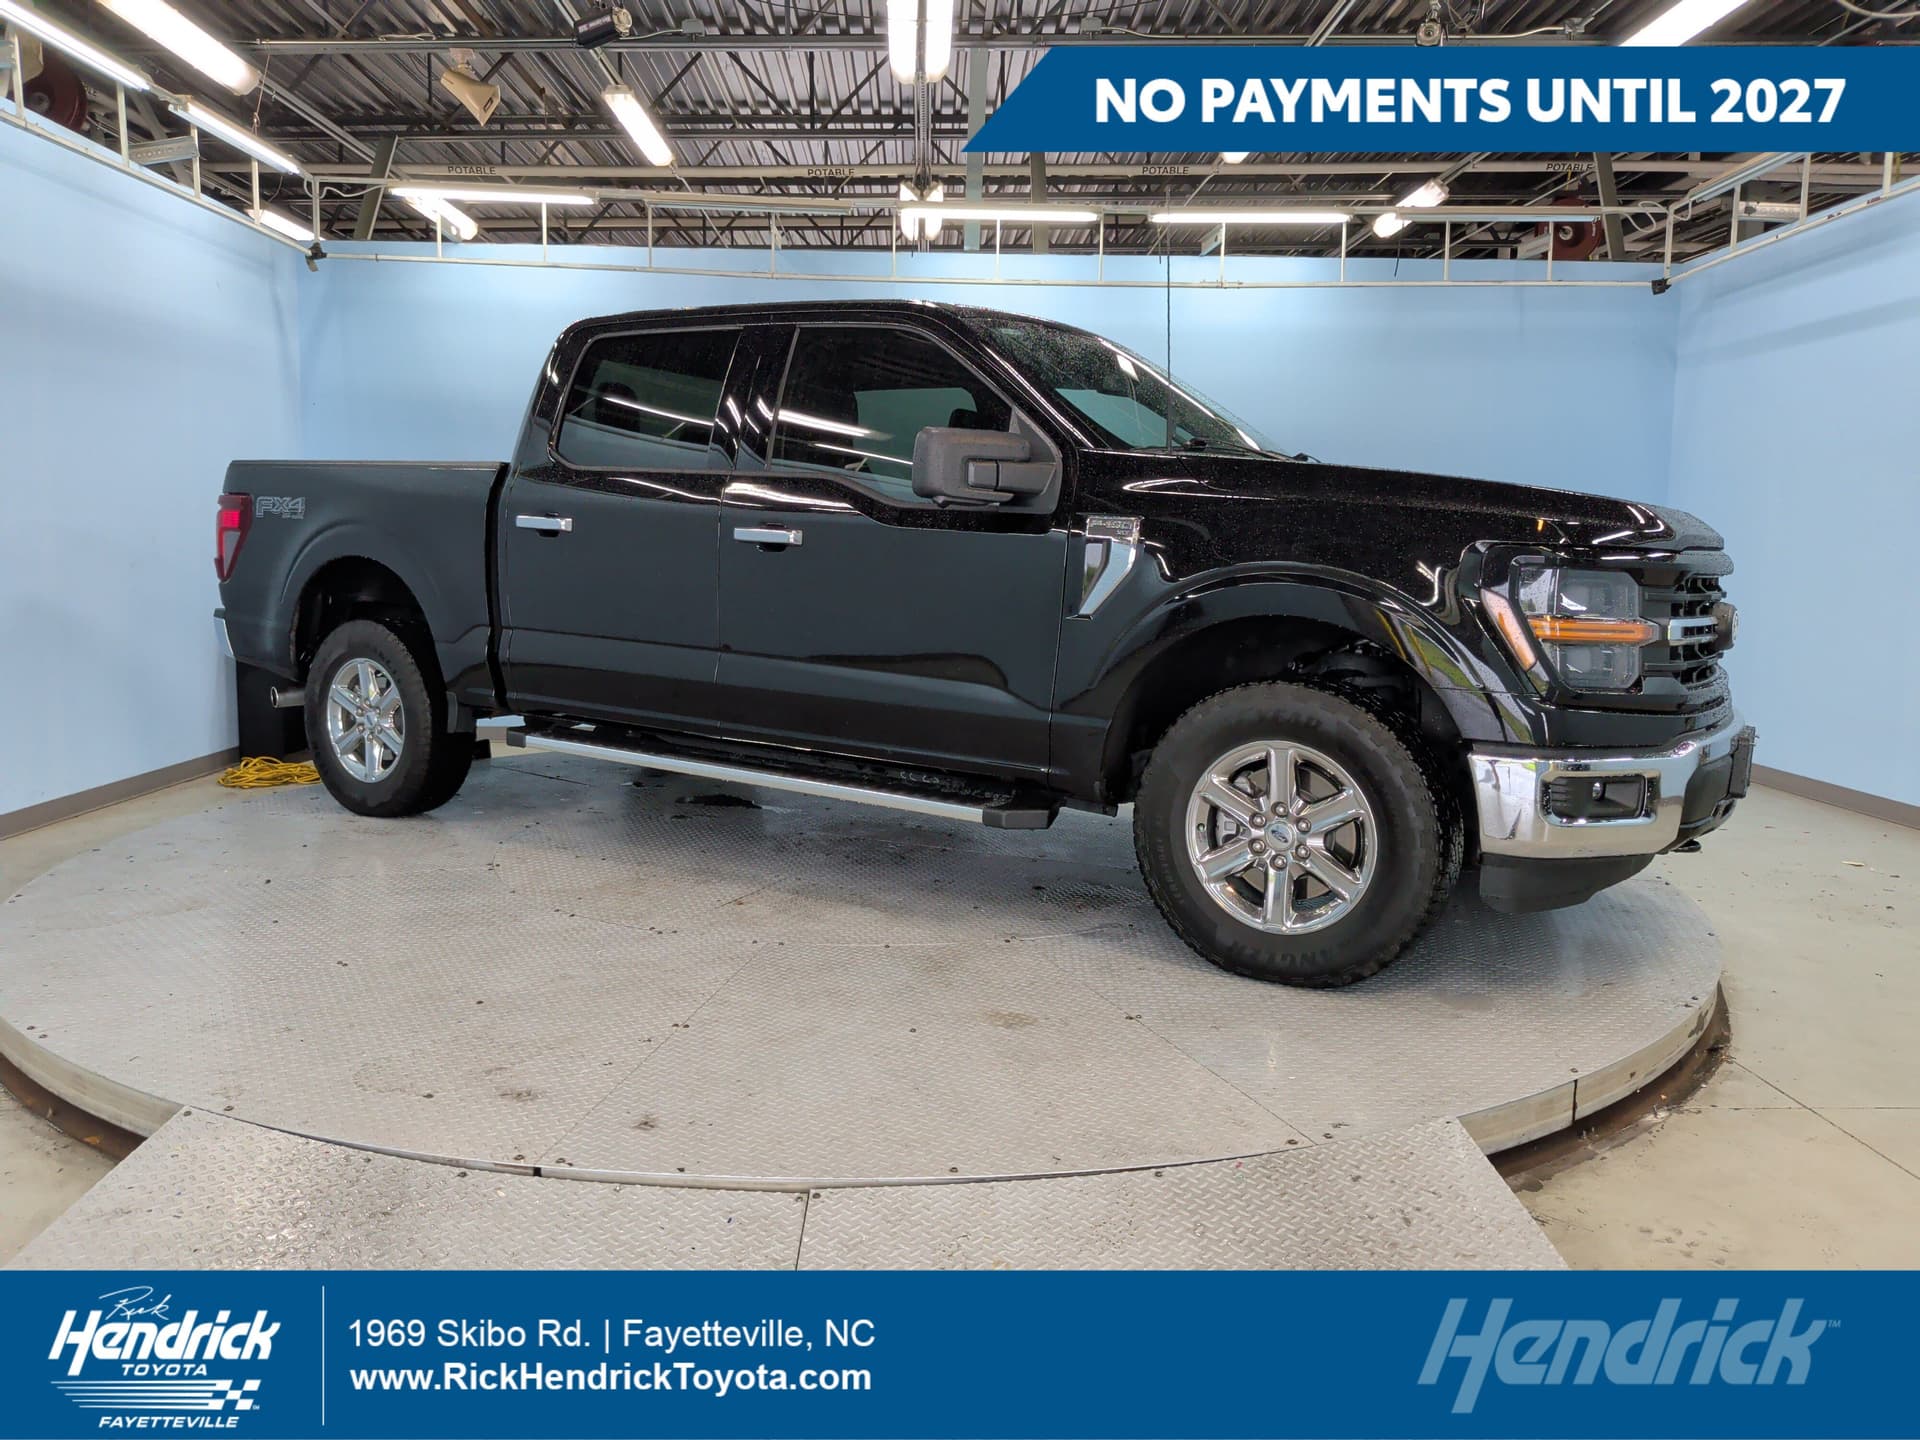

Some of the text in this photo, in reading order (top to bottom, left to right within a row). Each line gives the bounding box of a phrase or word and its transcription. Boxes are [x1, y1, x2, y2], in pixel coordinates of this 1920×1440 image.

[447, 165, 497, 175] POTABLE
[1142, 166, 1190, 175] POTABLE
[1546, 162, 1595, 171] POTABLE
[807, 168, 855, 176] POTABLE
[255, 496, 306, 519] FX4
